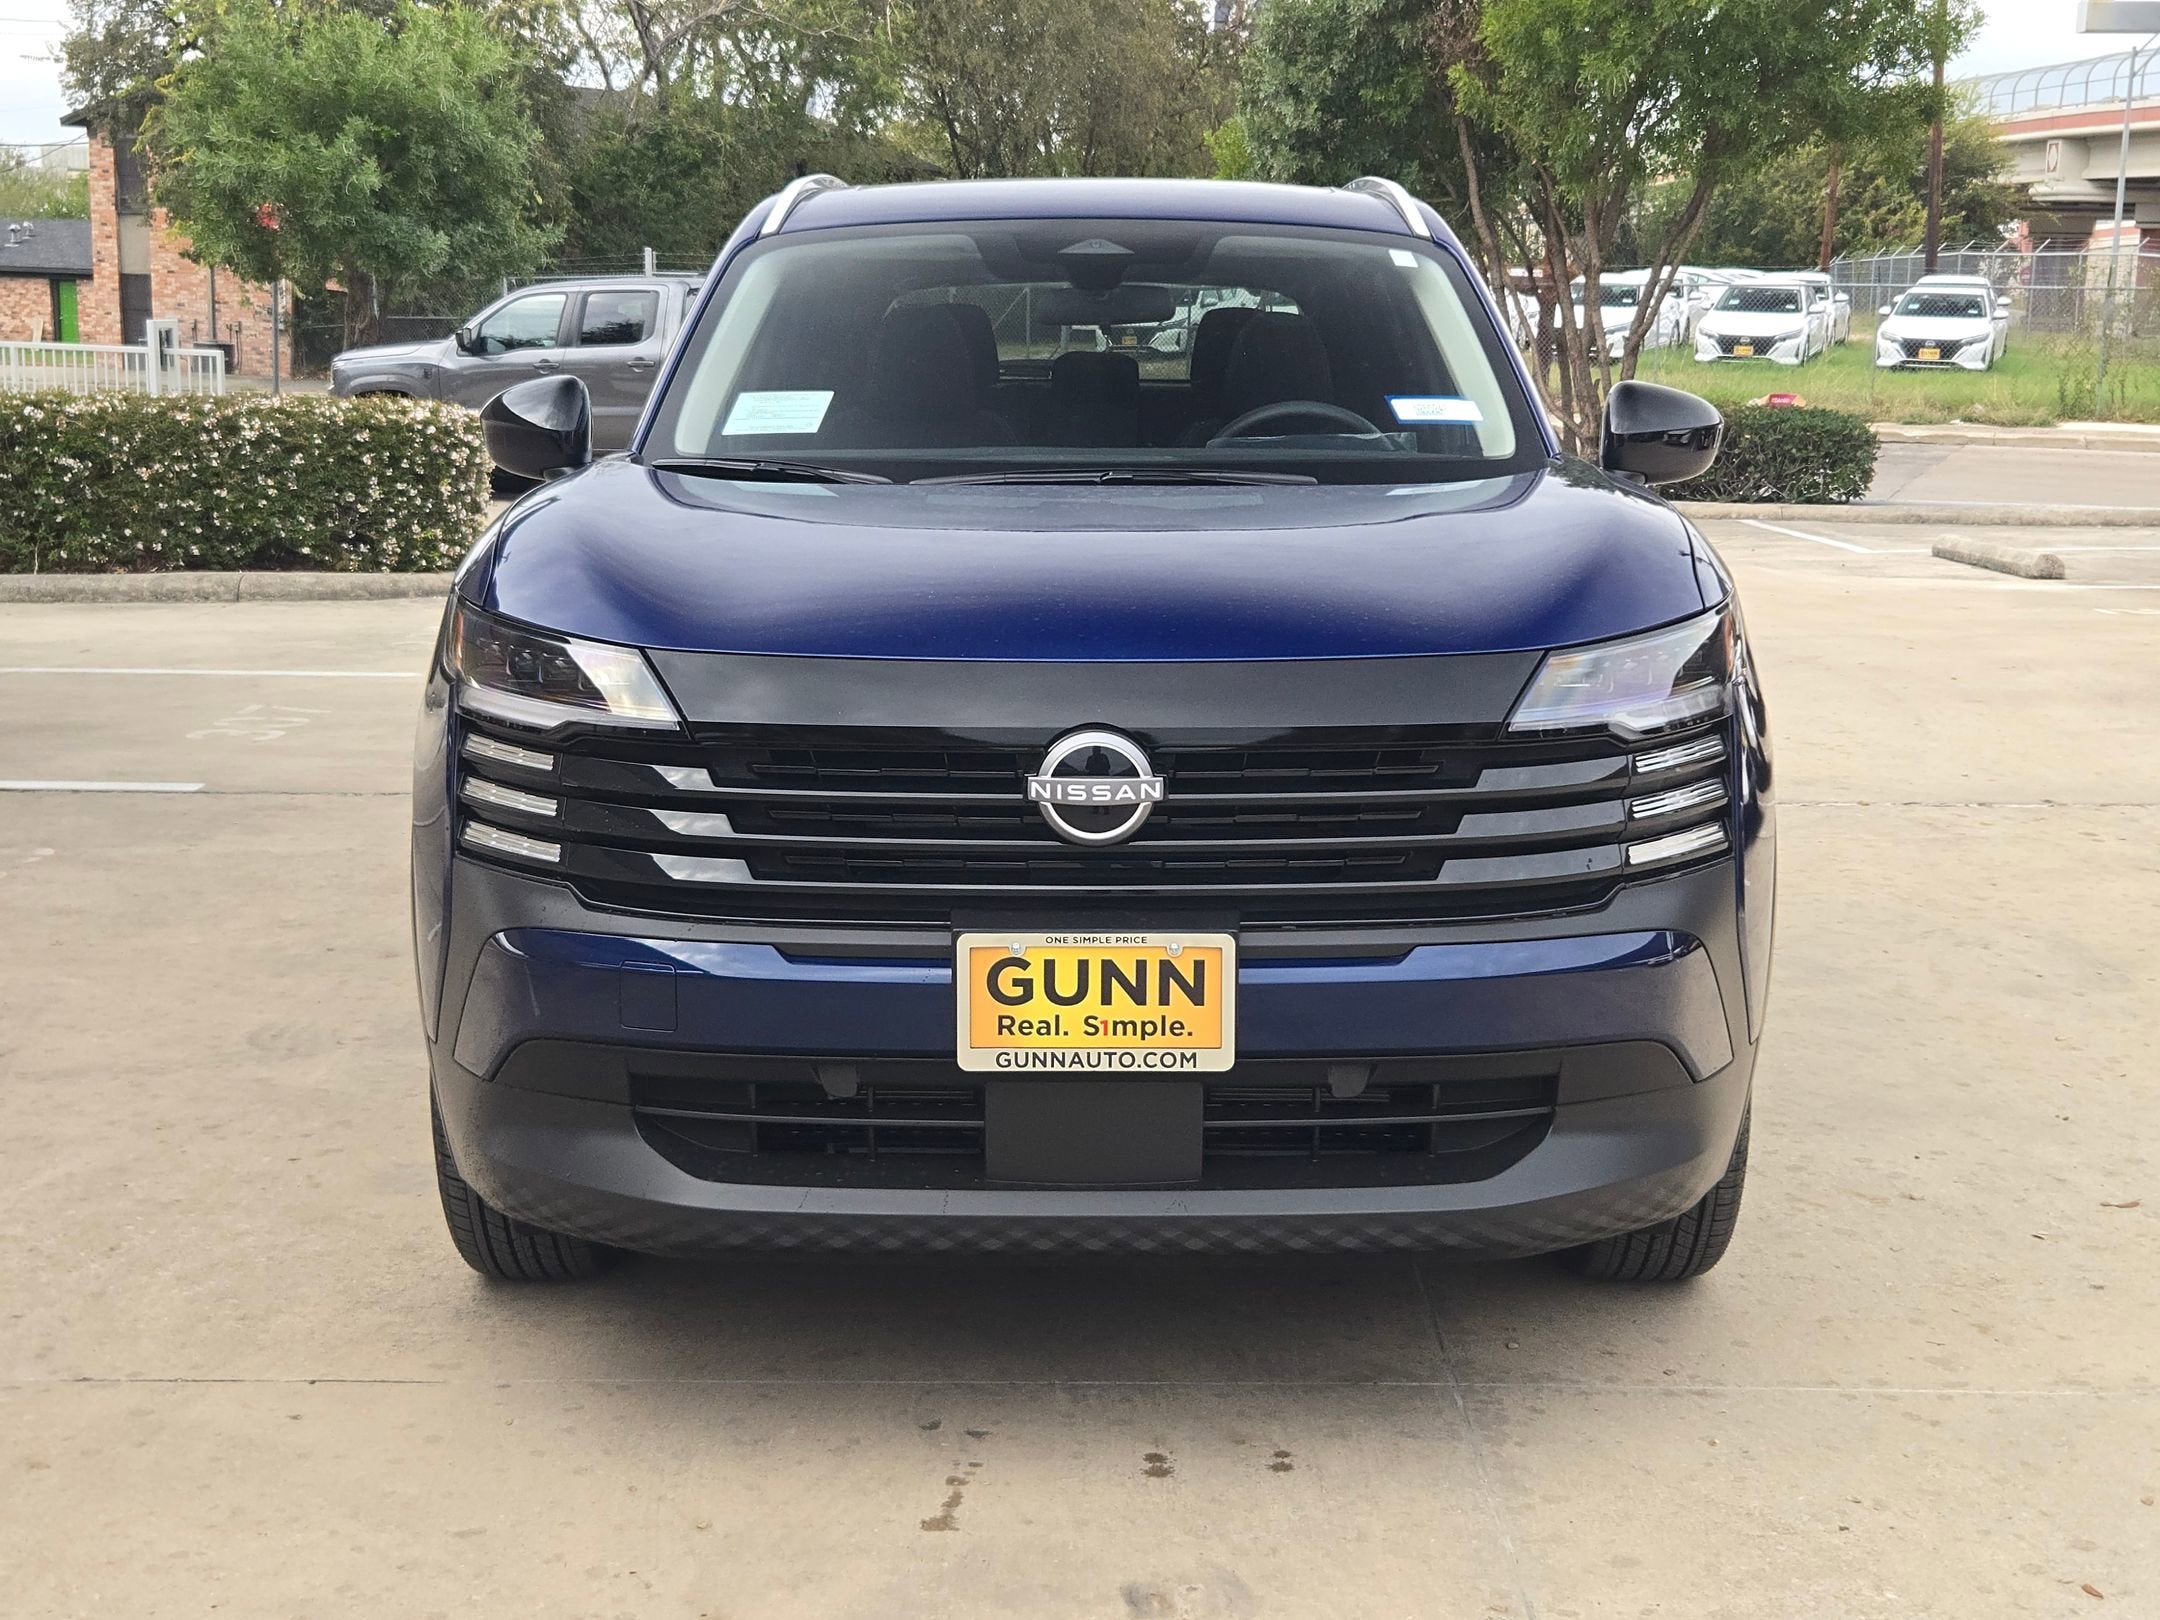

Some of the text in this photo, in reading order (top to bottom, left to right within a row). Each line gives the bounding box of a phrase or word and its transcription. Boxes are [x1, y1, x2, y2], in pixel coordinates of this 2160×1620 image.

[1030, 781, 1161, 801] NISSAN
[1045, 936, 1148, 944] ONE SIMPLE PRICE
[986, 956, 1206, 1007] GUNN
[997, 1014, 1069, 1037] Real.
[995, 1051, 1197, 1069] GUNNAUTO.COM
